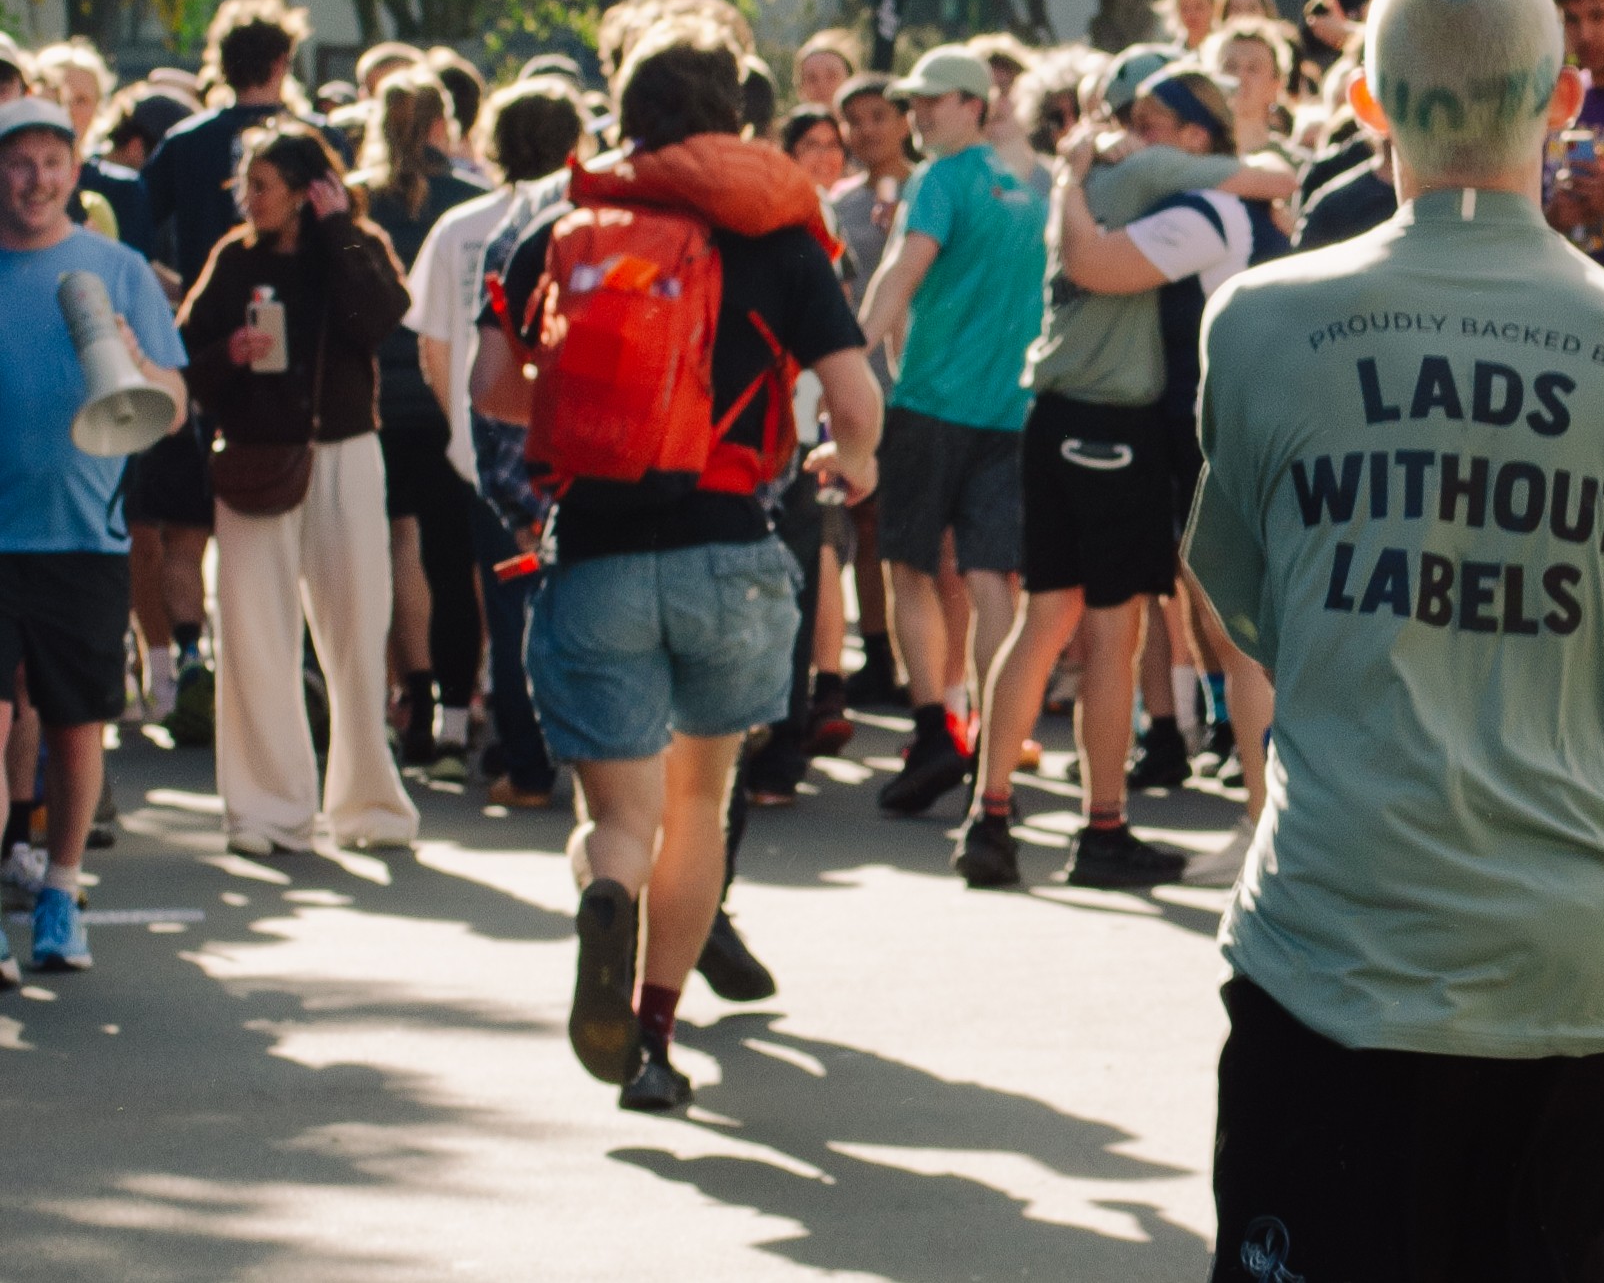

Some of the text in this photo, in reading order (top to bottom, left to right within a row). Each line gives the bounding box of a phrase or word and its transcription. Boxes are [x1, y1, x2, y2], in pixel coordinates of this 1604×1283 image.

[1308, 312, 1448, 353] PROUDLY
[1461, 317, 1582, 355] BACKED
[1356, 354, 1577, 437] LADS
[1324, 541, 1584, 636] LABELS
